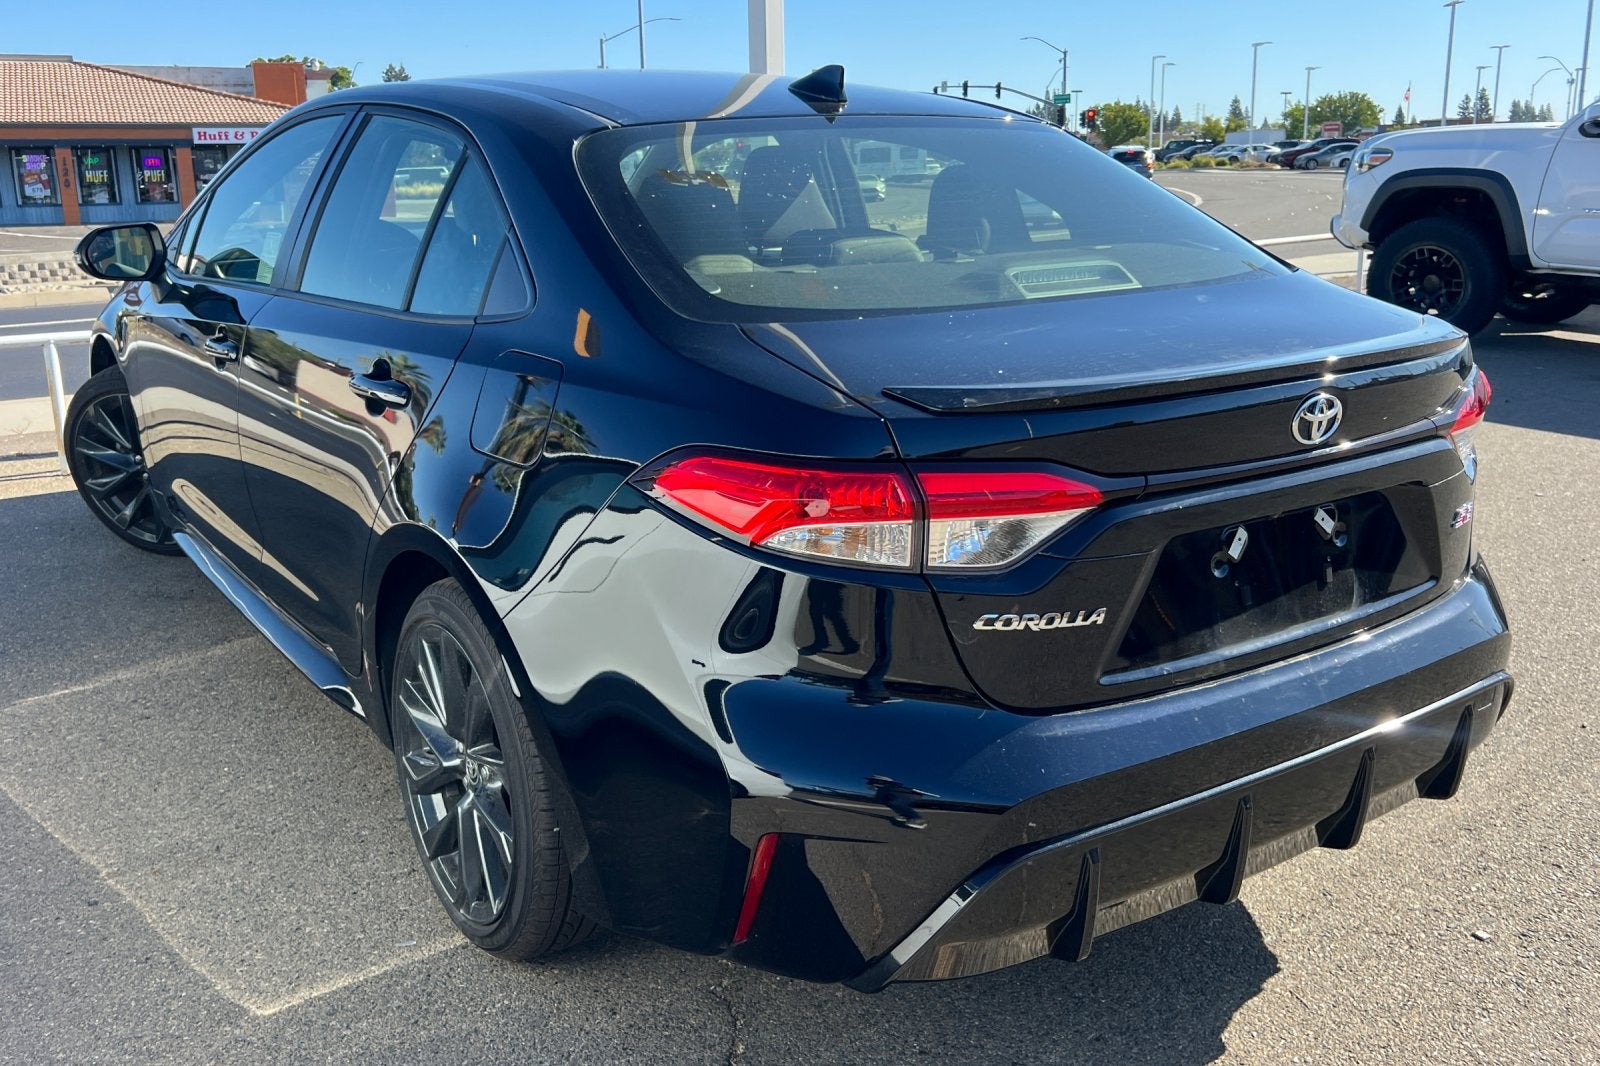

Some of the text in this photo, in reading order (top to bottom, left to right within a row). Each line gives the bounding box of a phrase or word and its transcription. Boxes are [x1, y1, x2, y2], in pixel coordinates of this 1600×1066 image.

[197, 131, 230, 141] Huff
[234, 131, 245, 140] &
[85, 170, 108, 183] HUFF
[972, 607, 1107, 632] COROLLA
